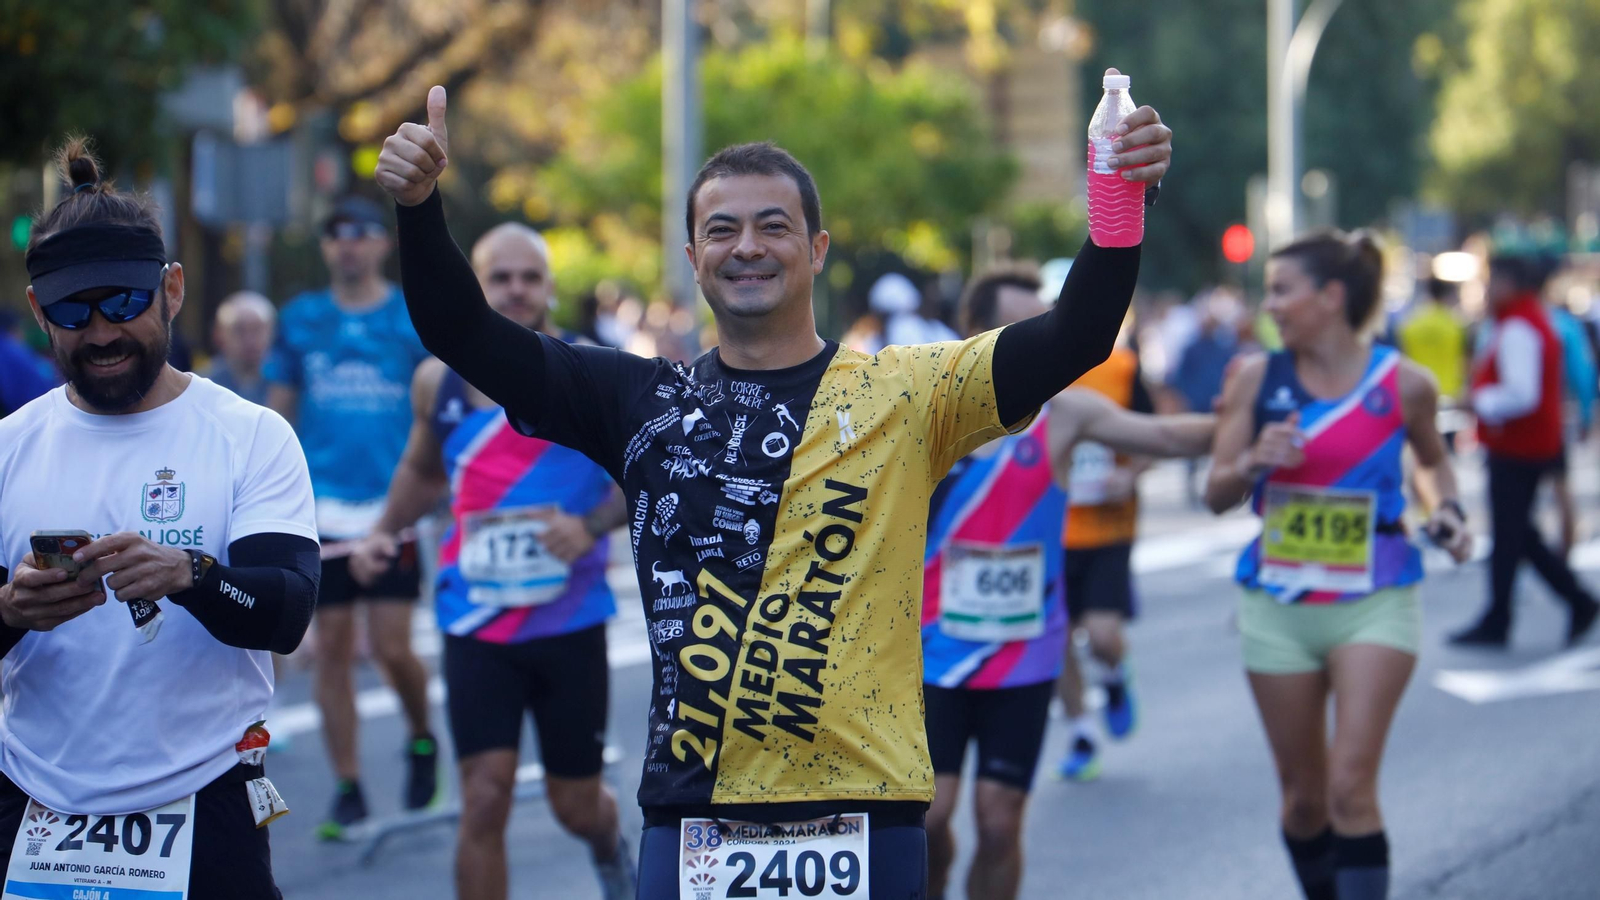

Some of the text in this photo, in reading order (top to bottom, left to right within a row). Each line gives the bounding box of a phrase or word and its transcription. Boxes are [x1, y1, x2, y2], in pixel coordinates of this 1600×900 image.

[730, 380, 766, 397] CORRE
[733, 393, 766, 410] MUERE
[652, 412, 669, 424] corre
[714, 509, 722, 518] TU
[712, 517, 744, 532] CORRE
[1287, 512, 1368, 545] 4195
[157, 525, 204, 546] JOSÉ
[688, 533, 724, 547] TIRADA
[696, 547, 725, 563] LARGA
[735, 552, 762, 570] RETO
[976, 567, 1034, 596] 606
[219, 580, 256, 610] IPRUN
[771, 478, 869, 744] MARATÓN
[732, 593, 791, 743] MEDIO
[646, 763, 670, 773] HAPPY
[54, 813, 187, 858] 2407
[686, 824, 723, 850] 38
[727, 825, 774, 840] MEDIA
[29, 861, 166, 879] JUAN ANTONIO GARCÍA ROMERO
[725, 850, 861, 899] 2409
[73, 877, 97, 885] VETERANO
[72, 887, 110, 900] CAJÓN 4
